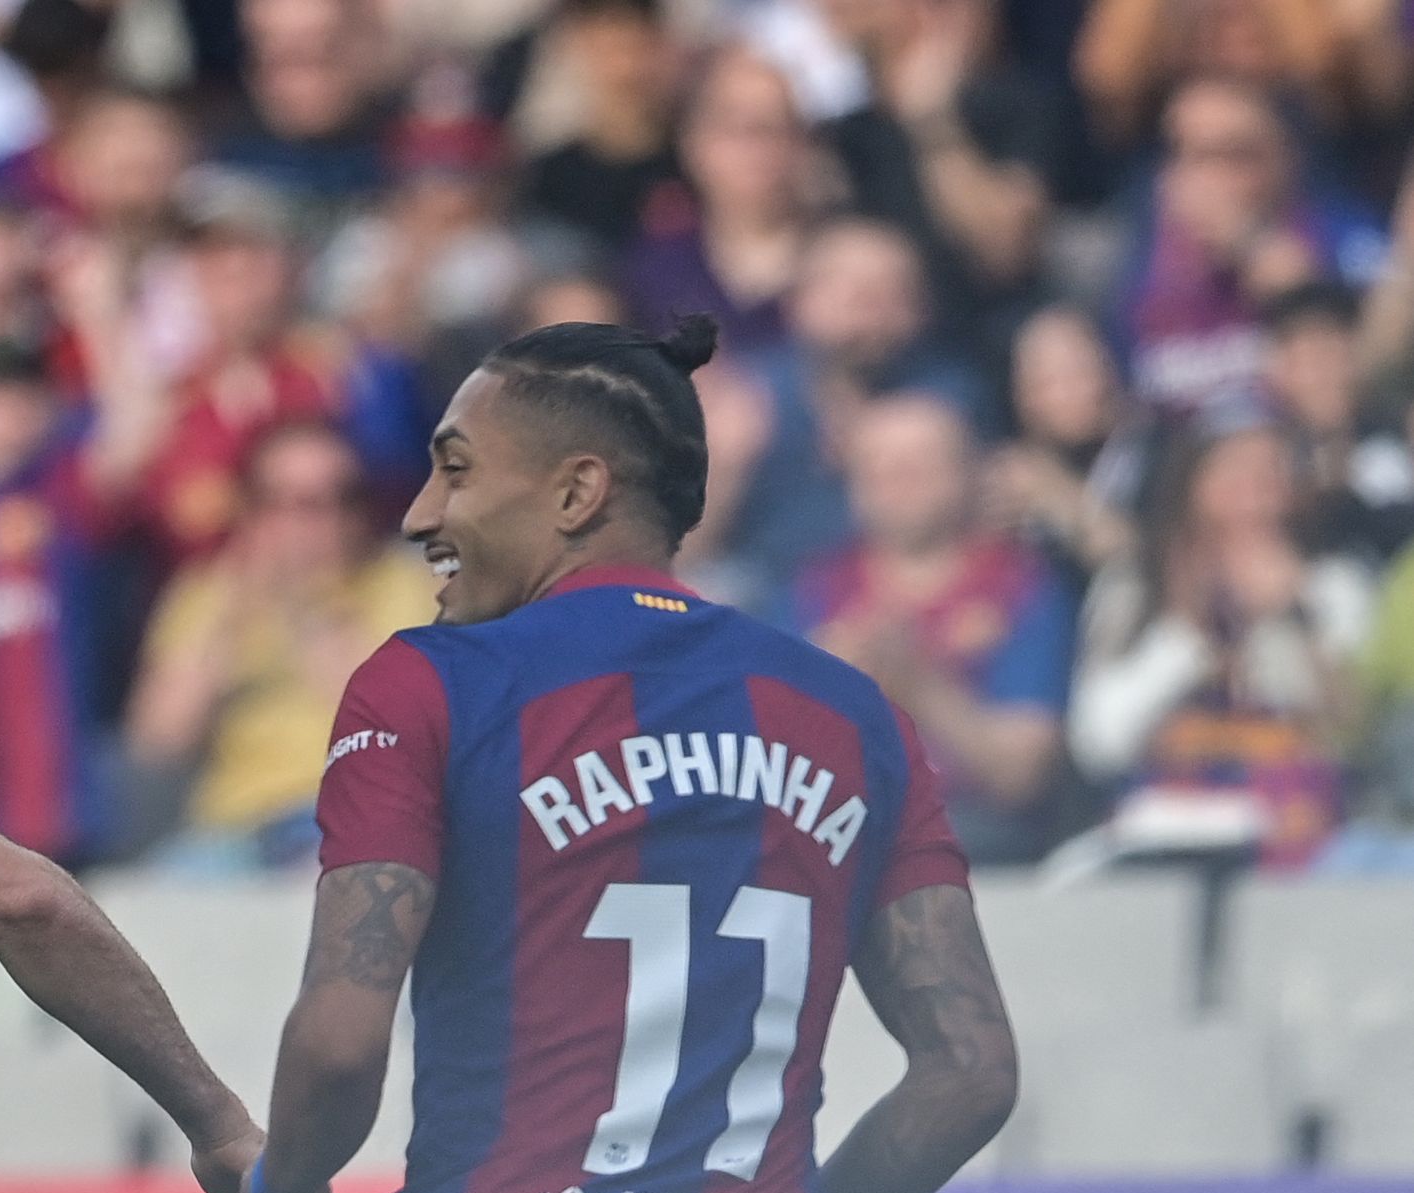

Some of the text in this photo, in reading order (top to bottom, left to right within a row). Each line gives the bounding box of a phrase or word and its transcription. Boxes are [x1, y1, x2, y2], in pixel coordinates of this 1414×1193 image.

[376, 731, 398, 748] tv
[519, 732, 869, 867] RAPHINHA
[582, 882, 812, 1182] 11
